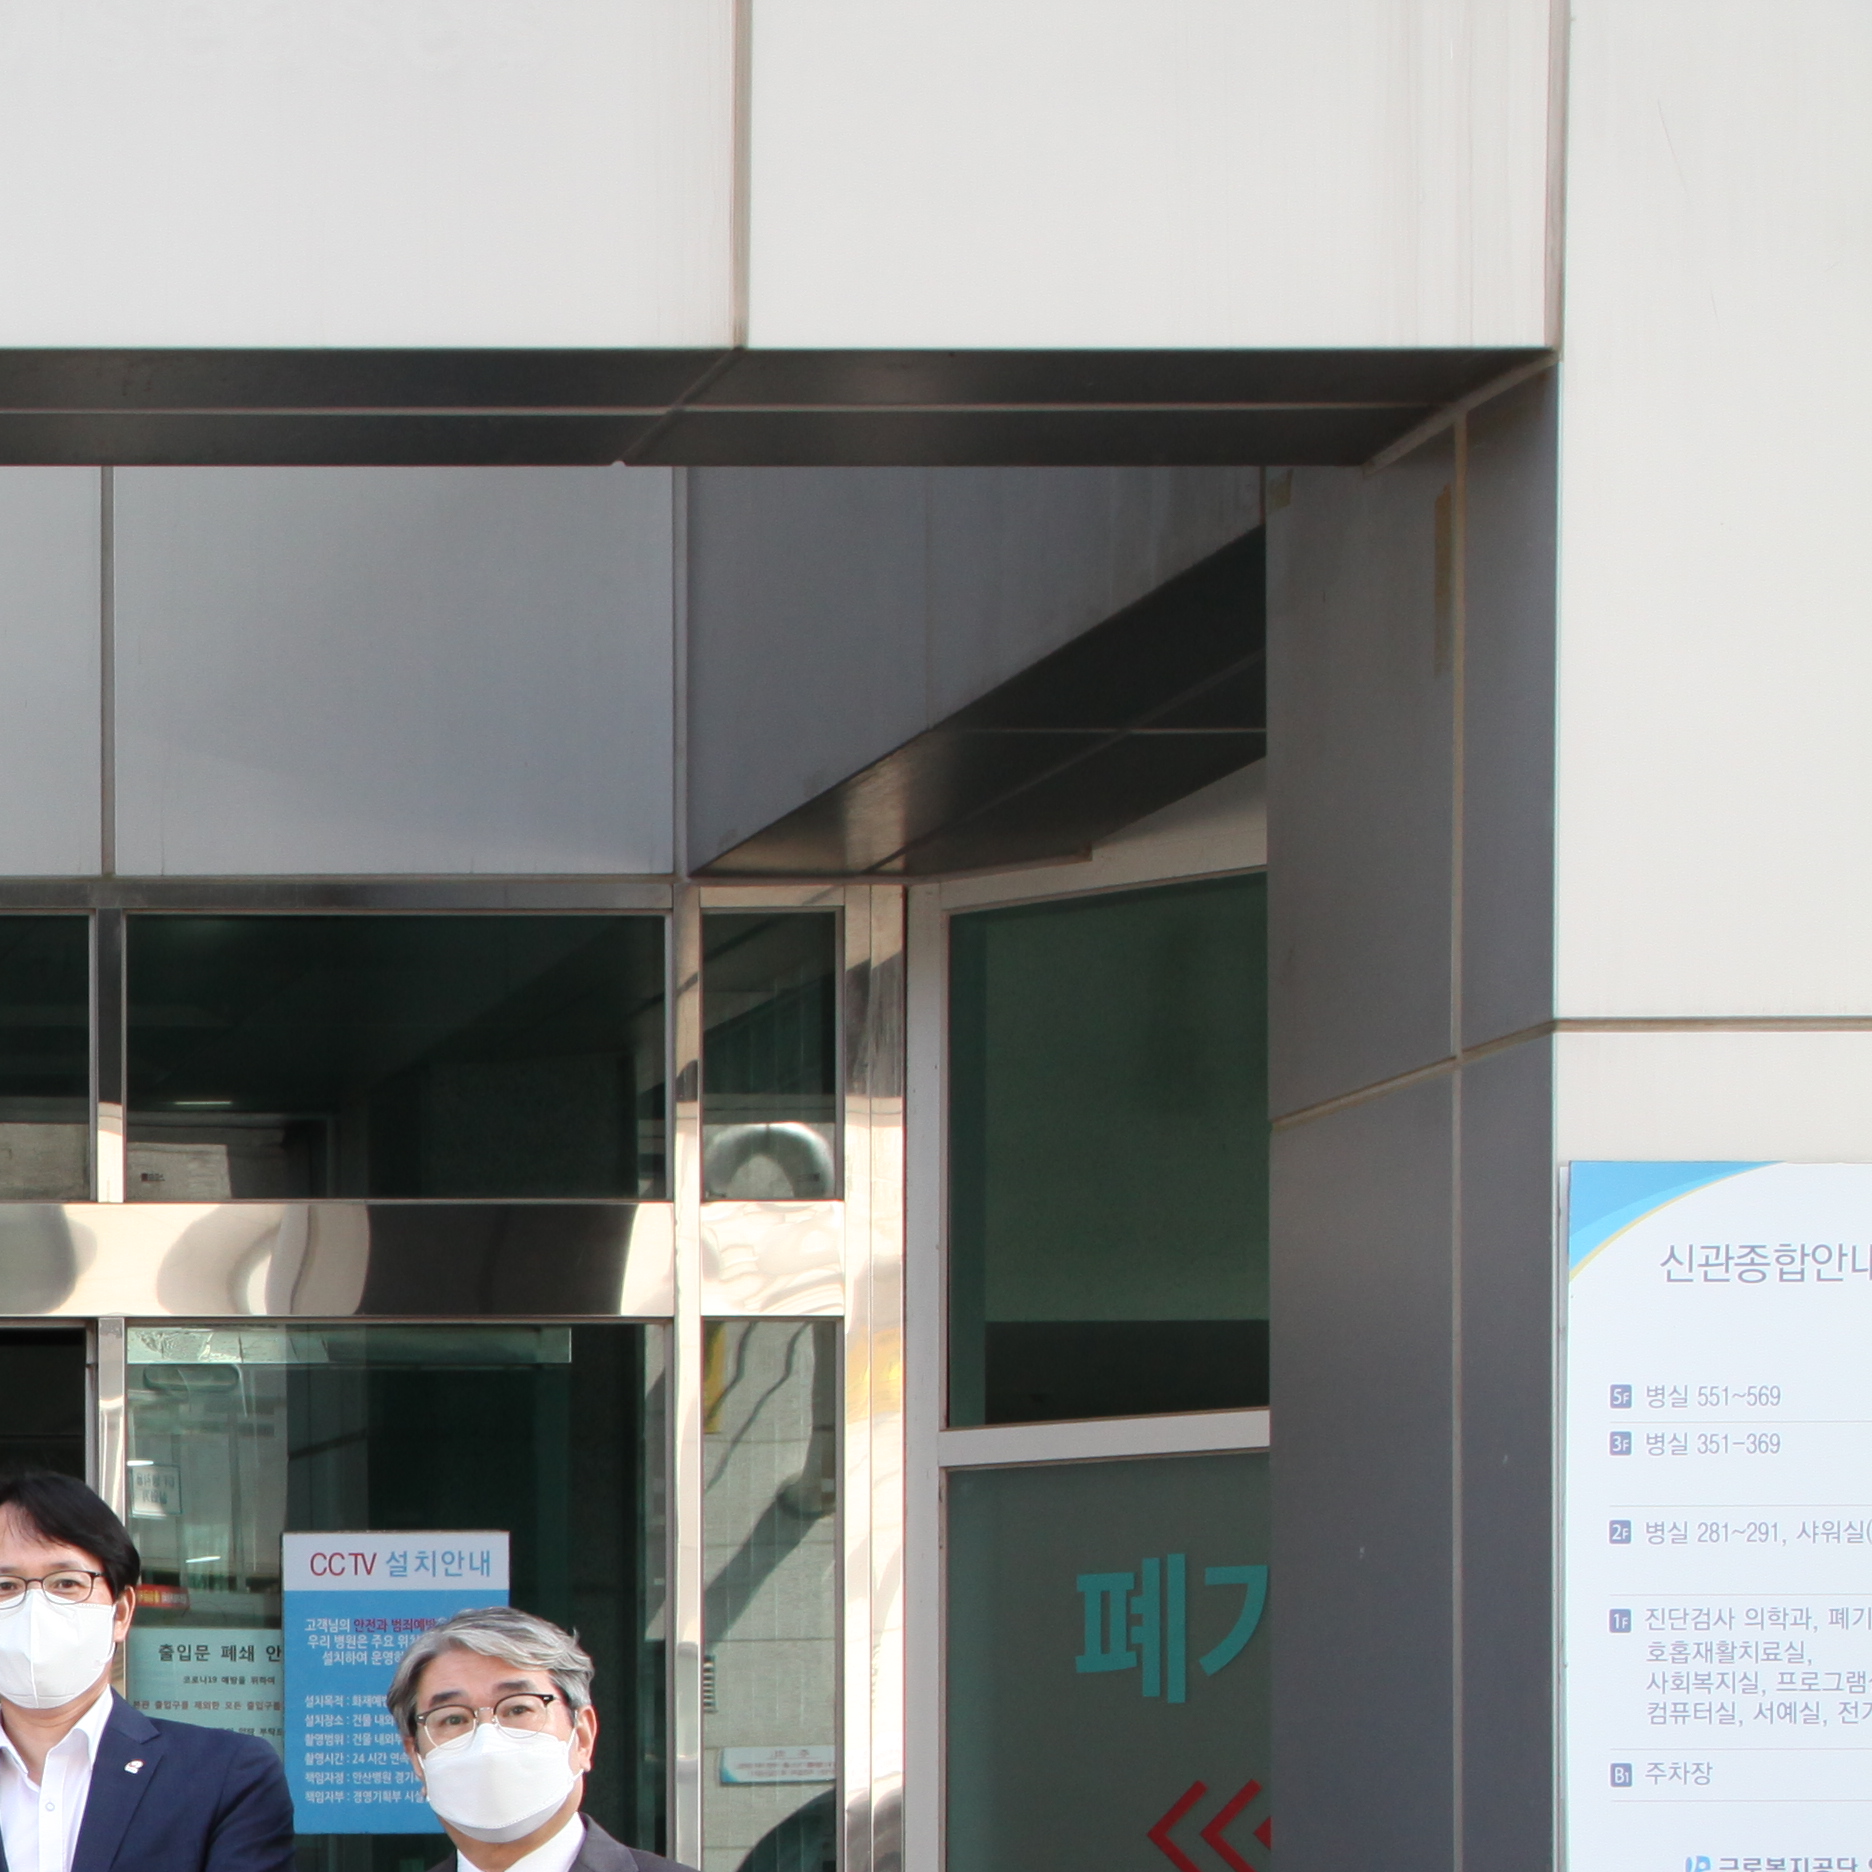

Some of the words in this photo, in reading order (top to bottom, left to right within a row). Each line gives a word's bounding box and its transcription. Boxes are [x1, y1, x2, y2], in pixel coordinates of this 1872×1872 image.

[1612, 1387, 1630, 1404] 5F
[1645, 1384, 1689, 1409] 병실
[1696, 1385, 1782, 1407] 551~569
[1612, 1435, 1630, 1451] 3F
[1645, 1432, 1689, 1456] 병실
[1611, 1524, 1629, 1541] 2F
[1644, 1520, 1689, 1544] 병실
[1696, 1521, 1788, 1547] 281~291,
[309, 1552, 377, 1577] CCTV
[385, 1549, 492, 1578] 설치안내
[304, 1618, 351, 1633] 고객님의
[391, 1618, 444, 1633] 범죄예방
[1644, 1607, 1736, 1632] 진단검사
[1743, 1607, 1819, 1634] 의학과,
[157, 1643, 211, 1663] 출입문
[221, 1643, 255, 1663] 폐쇄
[307, 1634, 330, 1649] 우리
[1646, 1640, 1813, 1666] 호흡재활치료실,
[1646, 1670, 1767, 1696] 사회복지실,
[1775, 1670, 1872, 1696] 프로그램
[1647, 1701, 1744, 1727] 컴퓨터실,
[1753, 1701, 1828, 1727] 서예실,
[1644, 1761, 1713, 1786] 주차장
